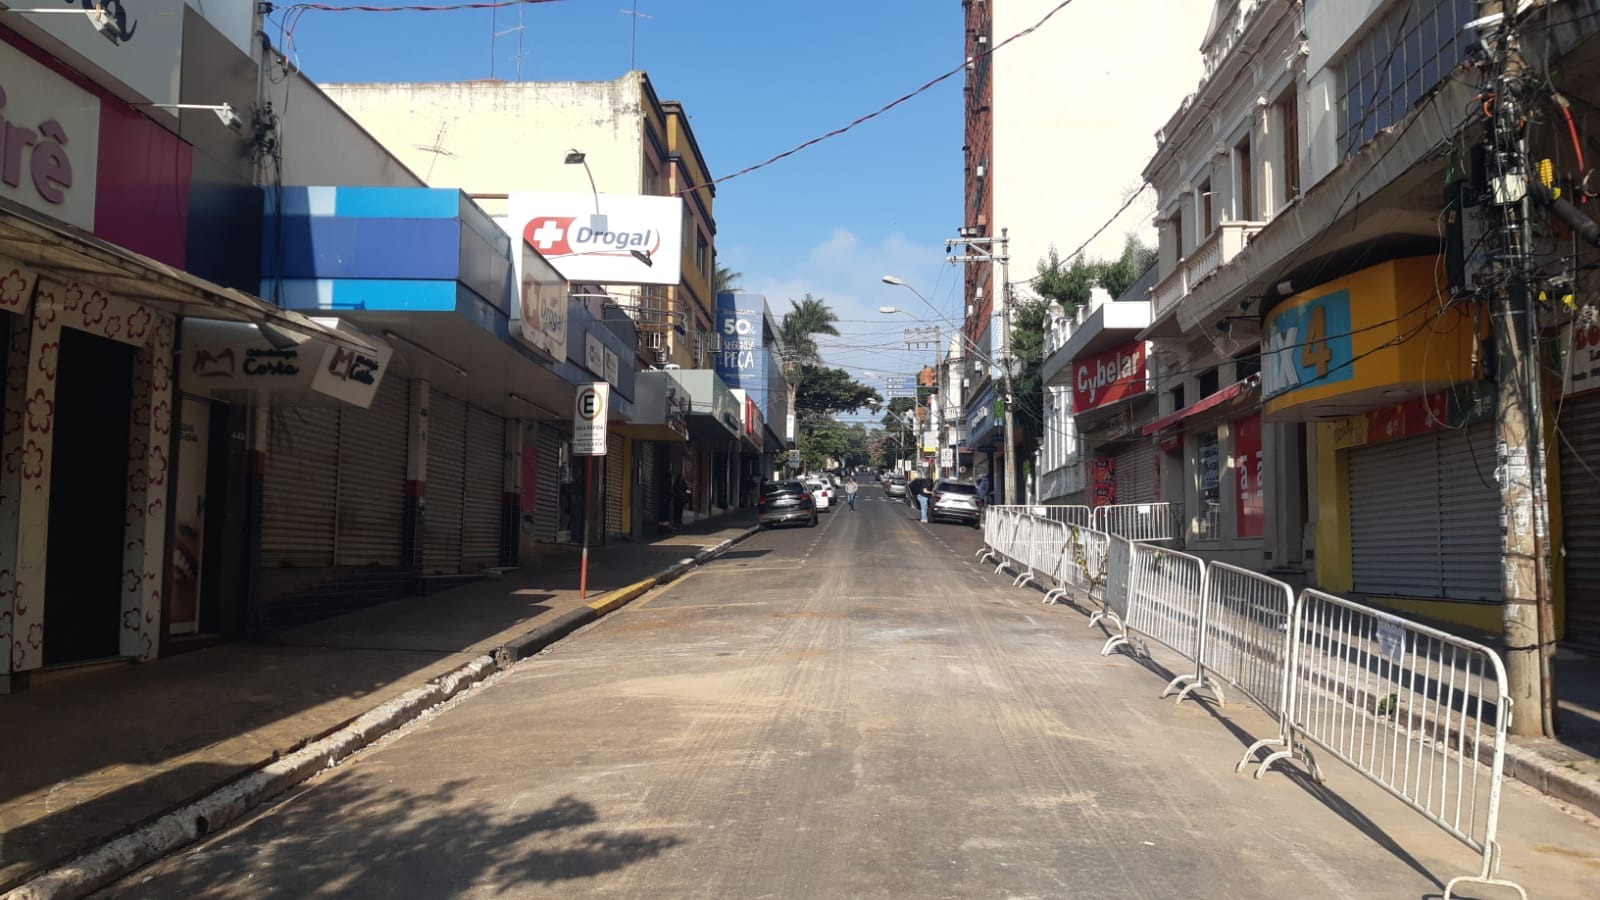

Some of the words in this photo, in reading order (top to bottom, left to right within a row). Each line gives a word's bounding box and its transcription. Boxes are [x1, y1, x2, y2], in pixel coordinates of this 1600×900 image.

[576, 227, 651, 249] Drogal
[541, 299, 563, 333] Drogal
[1302, 305, 1332, 380] 4
[243, 358, 300, 375] Costa
[724, 351, 755, 371] PEÇA
[1078, 352, 1140, 404] Cybelar
[584, 395, 594, 414] E
